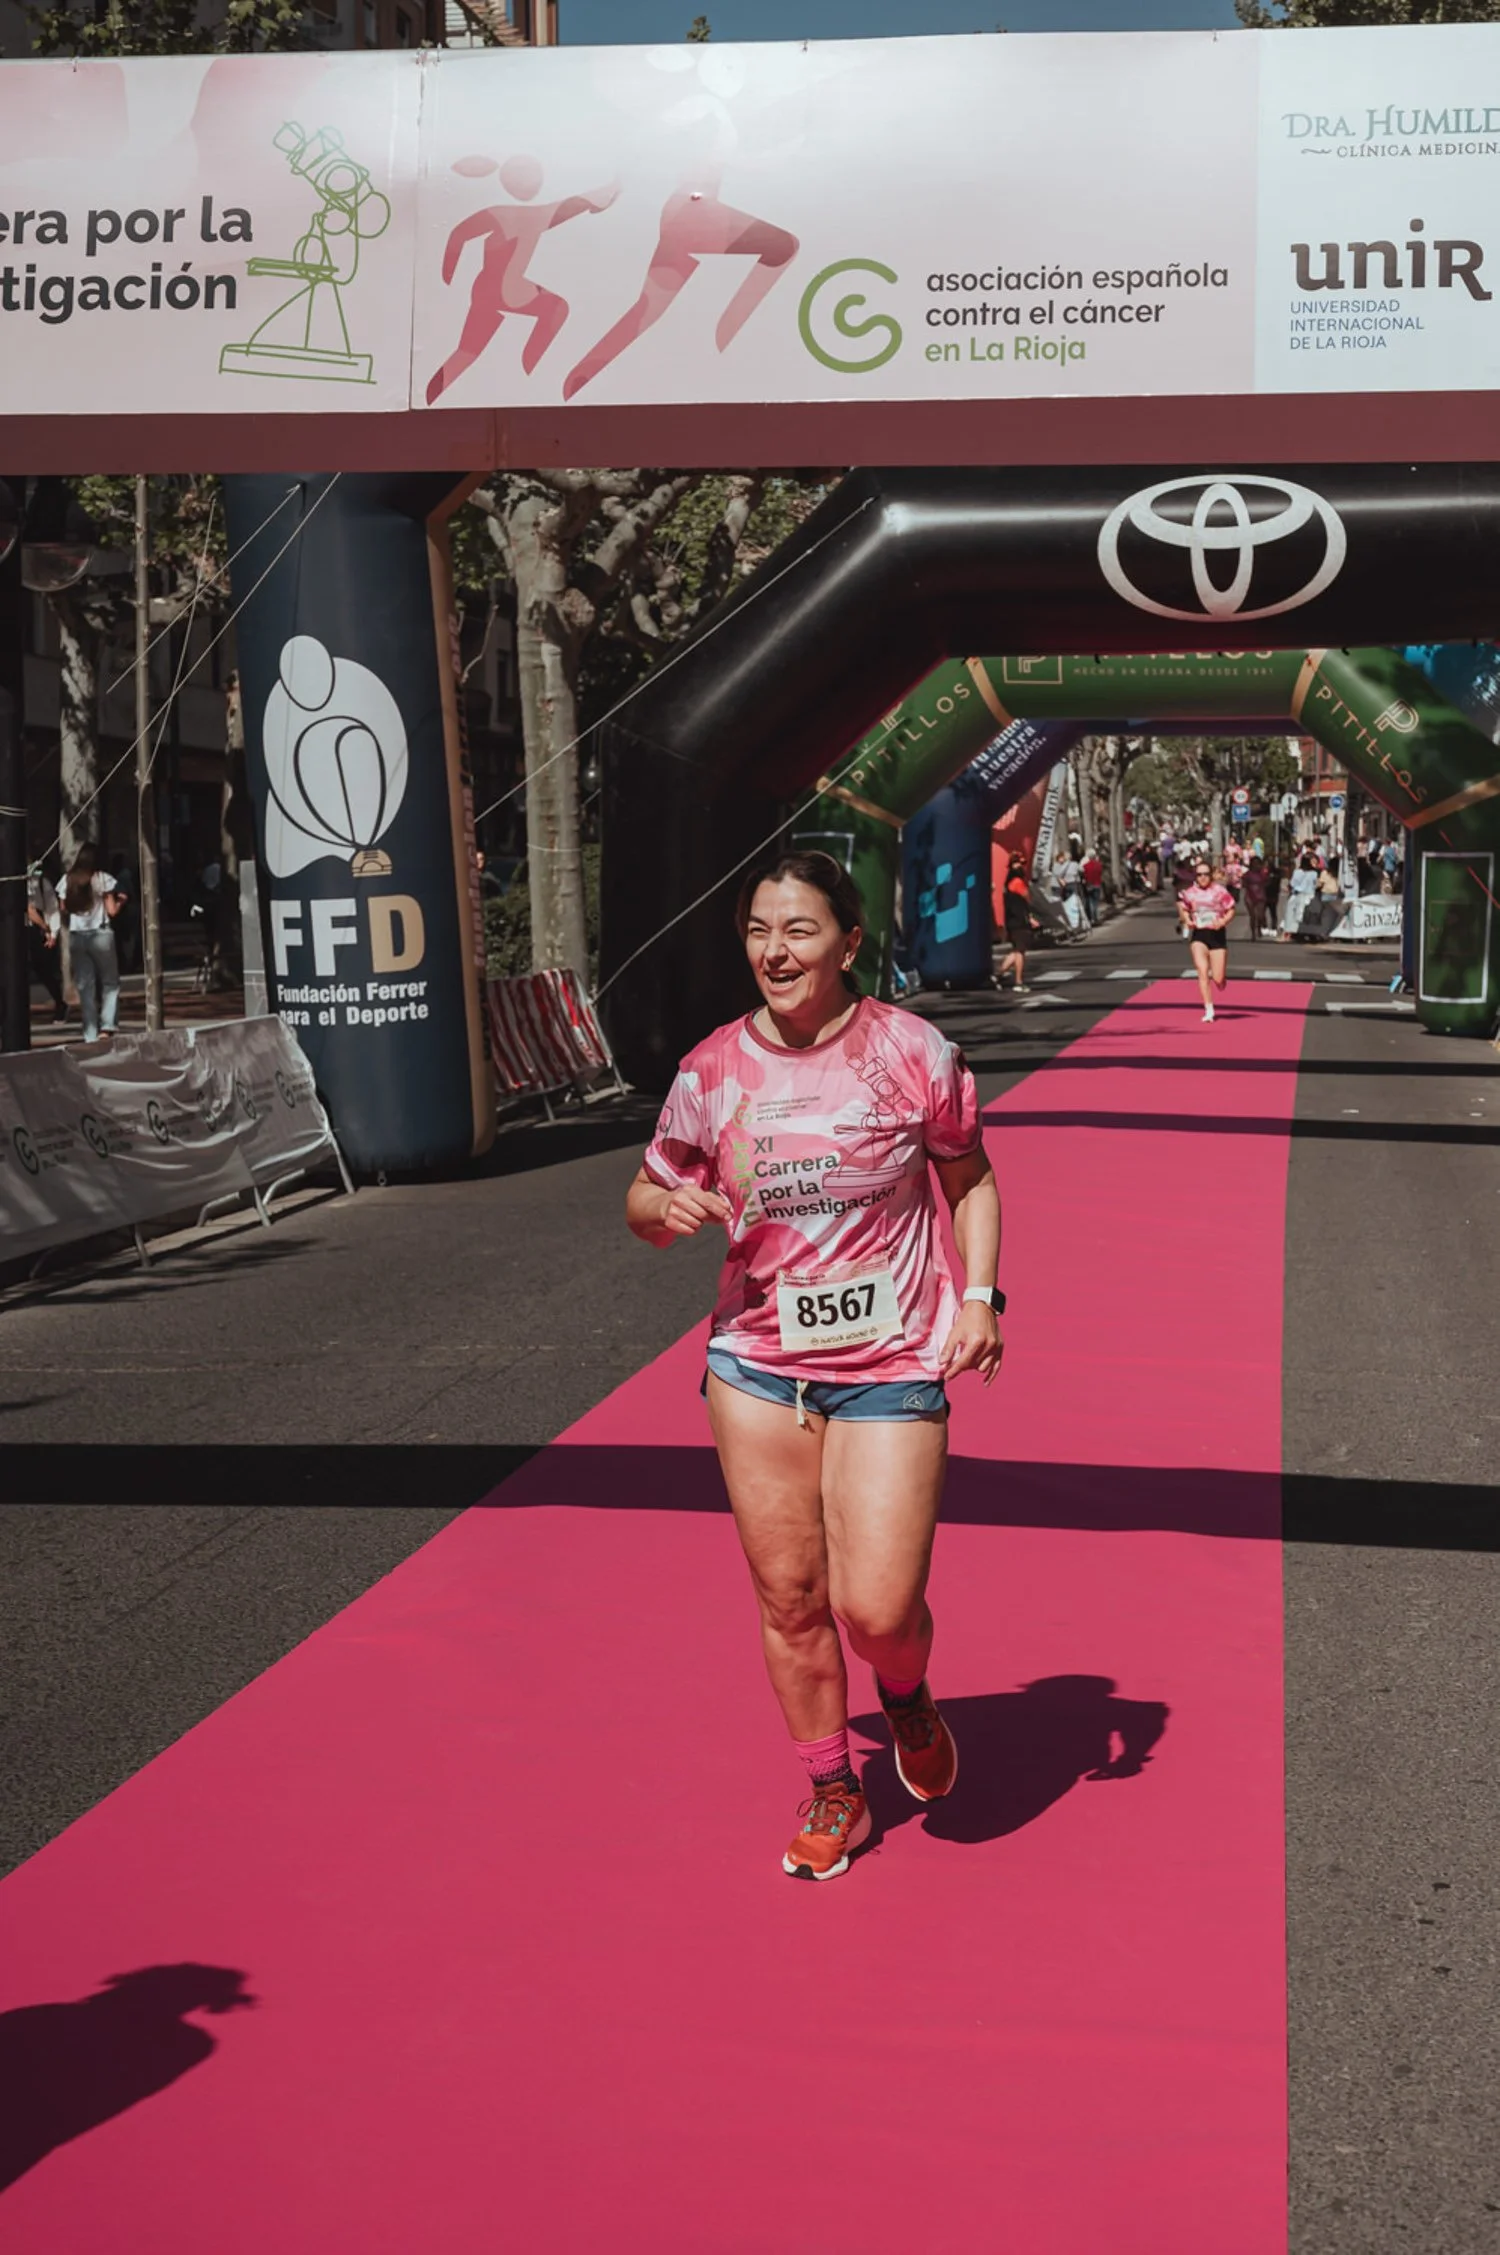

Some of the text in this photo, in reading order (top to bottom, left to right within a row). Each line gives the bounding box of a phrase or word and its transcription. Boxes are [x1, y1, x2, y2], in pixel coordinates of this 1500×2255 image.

[1336, 144, 1412, 158] CLÍNICA
[86, 208, 186, 257] por
[200, 195, 253, 243] la
[926, 262, 1229, 295] asociación española
[925, 299, 1165, 326] contra el cáncer
[1290, 300, 1400, 314] UNIVERSIDAD
[1290, 317, 1424, 331] INTERNACIONAL
[924, 335, 1086, 366] en La Rioja
[1290, 336, 1387, 350] DE LA RIOJA
[270, 894, 425, 976] FFD
[277, 981, 427, 1004] Fundación Ferrer
[318, 1007, 336, 1026] el
[346, 1001, 429, 1027] Deporte
[754, 1136, 774, 1155] XI
[754, 1155, 838, 1178] Carrera
[759, 1180, 820, 1206] por la
[764, 1185, 897, 1218] Investigación
[797, 1283, 876, 1328] 8567
